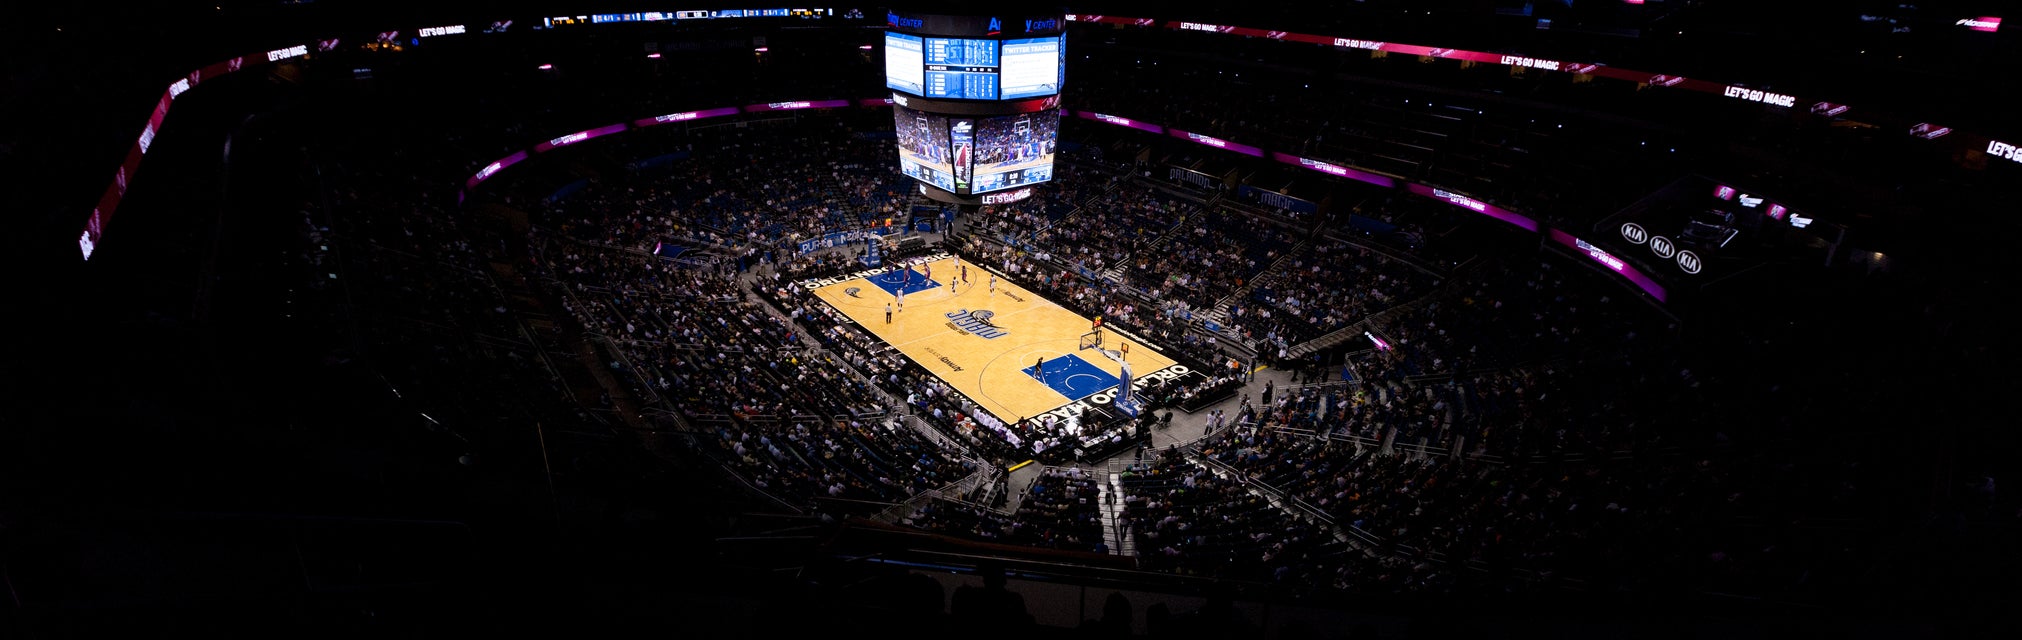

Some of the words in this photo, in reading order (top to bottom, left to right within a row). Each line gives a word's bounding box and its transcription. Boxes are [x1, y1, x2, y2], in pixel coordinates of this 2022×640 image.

[1501, 55, 1523, 66] LET'S
[1522, 57, 1534, 68] GO
[1534, 59, 1559, 71] MAGIC
[1724, 85, 1750, 99] LET'S
[1749, 90, 1763, 102] GO
[1763, 92, 1796, 107] MAGIC
[1986, 140, 2016, 159] LET'S
